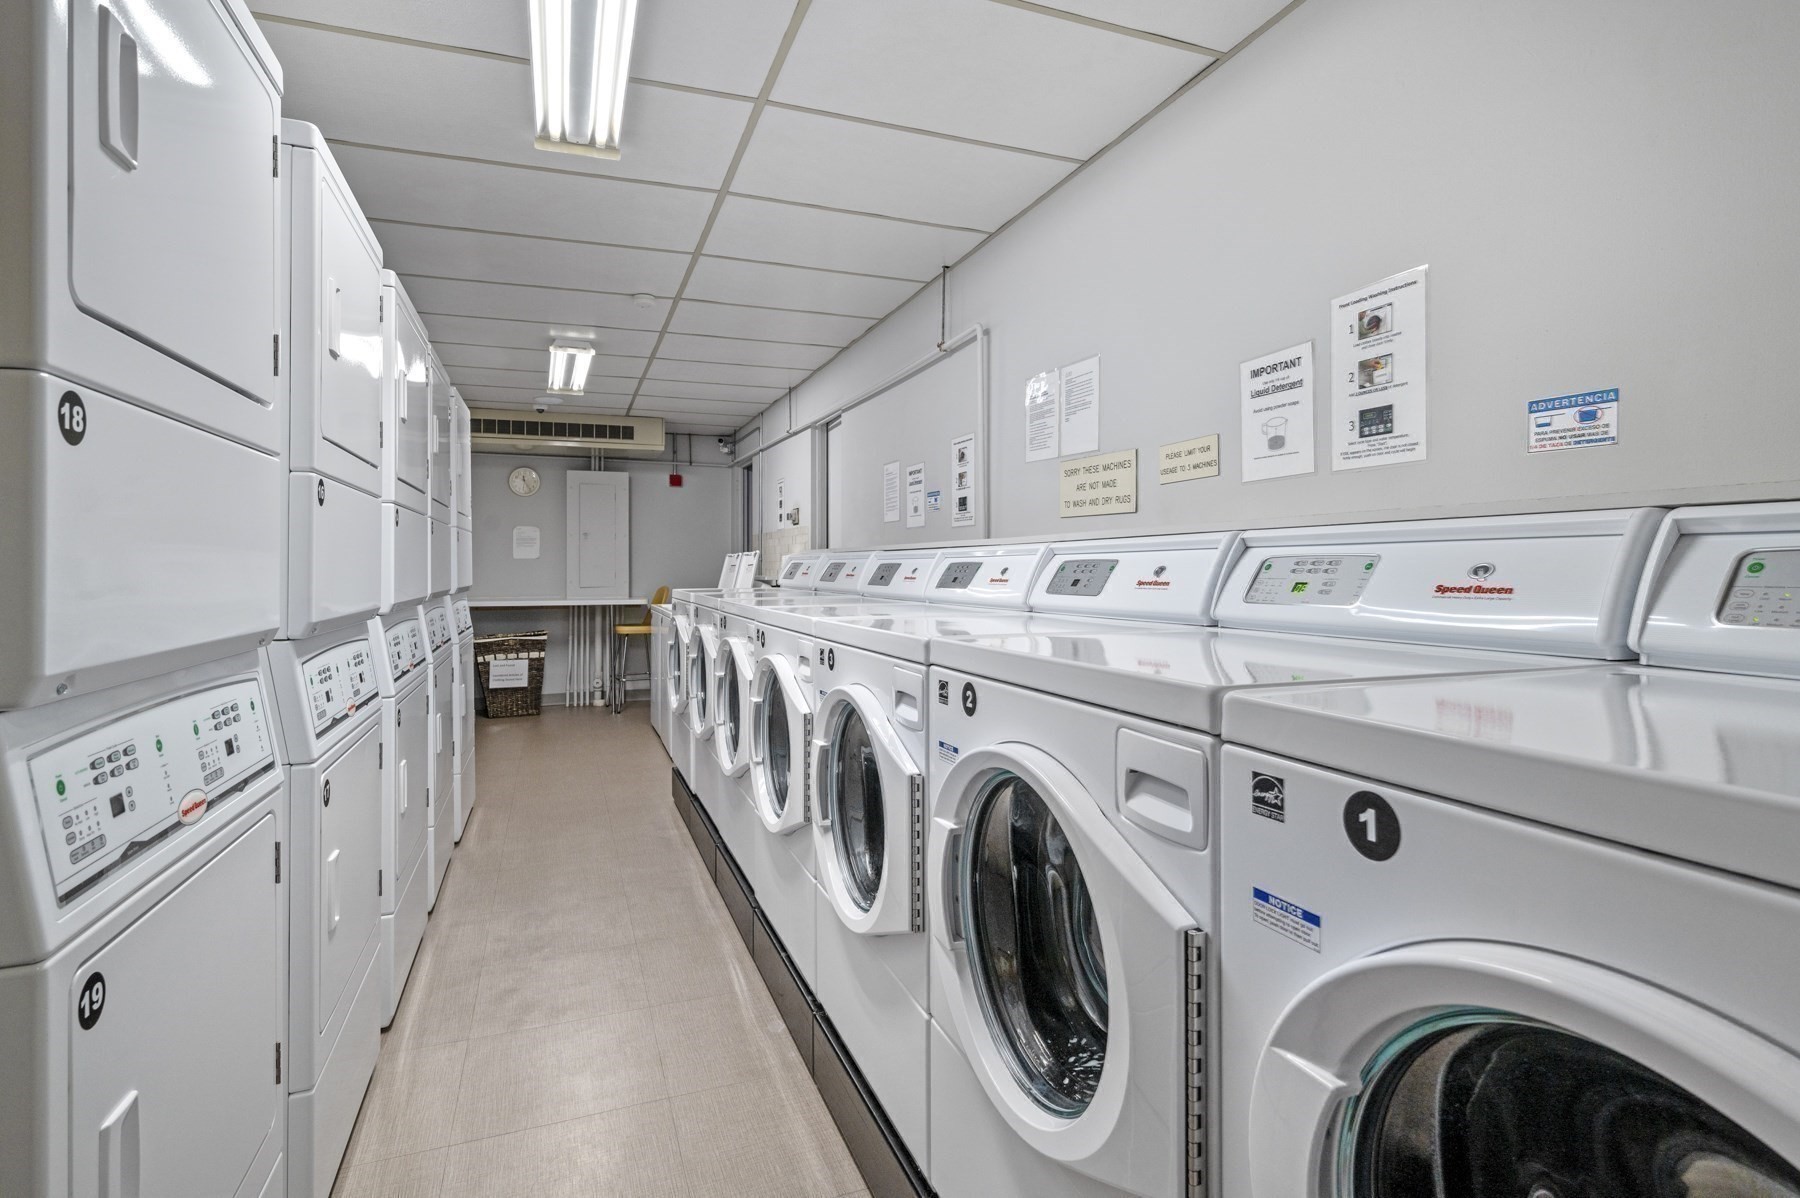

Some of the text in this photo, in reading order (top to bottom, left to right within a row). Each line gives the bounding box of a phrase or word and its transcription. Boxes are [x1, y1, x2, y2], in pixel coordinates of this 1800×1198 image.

[1349, 324, 1354, 334] 1
[1250, 356, 1302, 379] IMPORTANT
[1348, 372, 1354, 383] 2
[1250, 379, 1303, 398] Liquid Detergent
[1530, 391, 1616, 412] ADVERTENCIA
[60, 402, 84, 433] 18
[1348, 420, 1355, 432] 3
[1165, 444, 1211, 460] PLEASE LIMIT YOUR
[1063, 459, 1132, 478] SORRY THESE MACHINES
[1160, 459, 1217, 476] USEAGE TO 3 MACHINES
[1076, 478, 1117, 492] ARE NOT MADE
[1064, 494, 1131, 509] TO WASH AND DRY RUGS
[1135, 579, 1153, 587] Speed
[1434, 584, 1513, 595] Speed Queen
[965, 690, 973, 708] 2
[181, 803, 195, 817] Speed
[1252, 805, 1270, 818] ENERGY
[1358, 808, 1376, 843] 1
[1268, 895, 1303, 919] NOTICE
[80, 981, 103, 1019] 19
